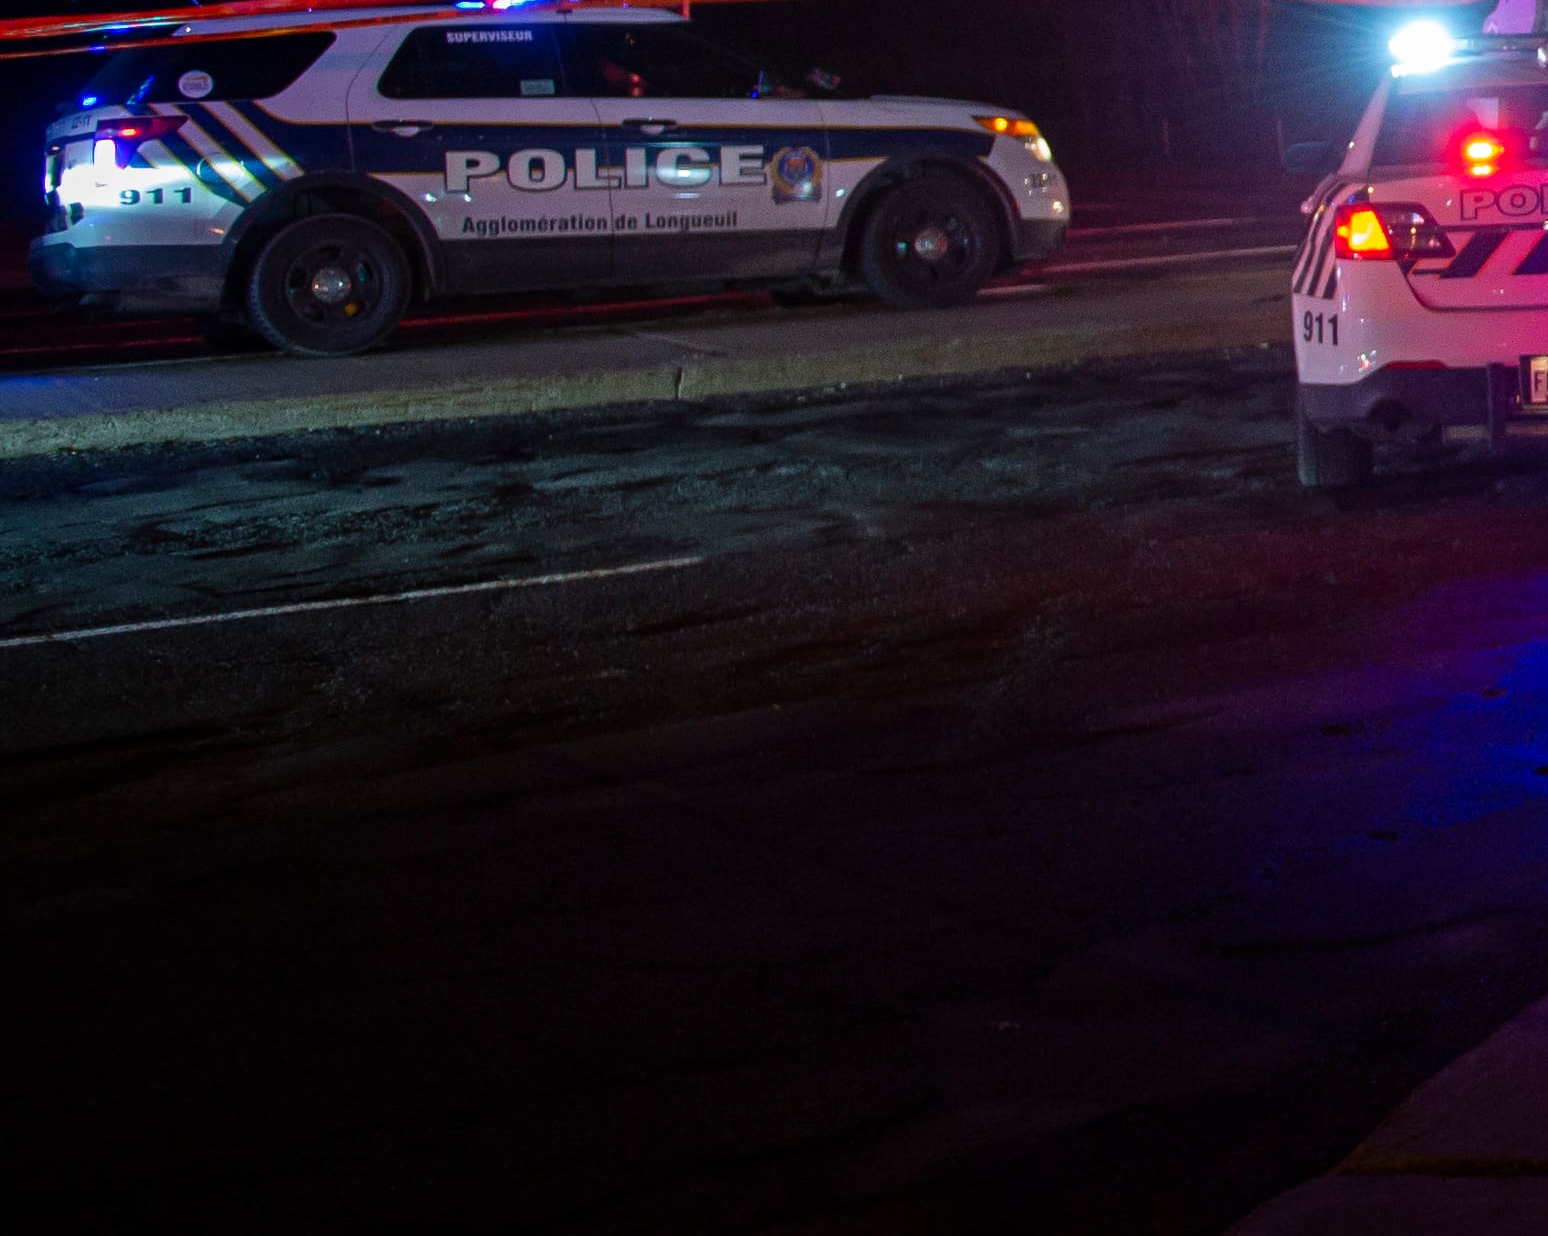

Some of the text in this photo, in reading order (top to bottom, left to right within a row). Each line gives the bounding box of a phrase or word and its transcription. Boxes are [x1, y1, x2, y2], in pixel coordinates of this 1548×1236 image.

[446, 30, 533, 44] SUPERVISEUR
[445, 144, 767, 194] POLICE
[119, 187, 192, 205] 911
[463, 210, 738, 238] Agglomération de Longueuil
[1303, 311, 1340, 346] 911
